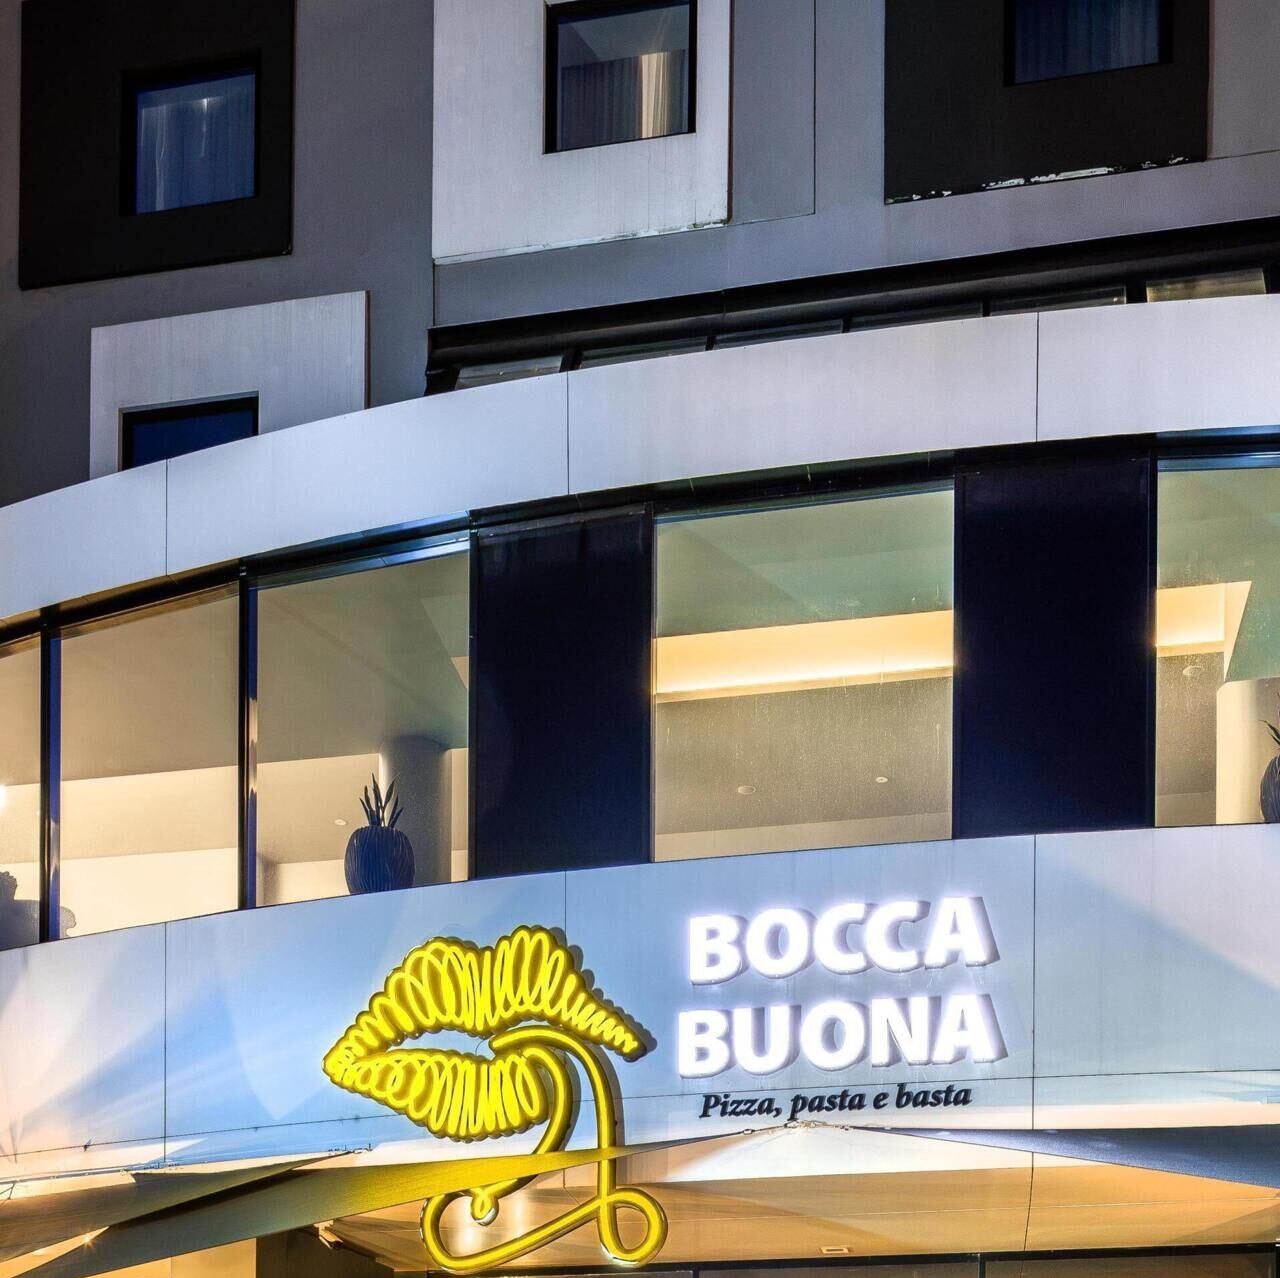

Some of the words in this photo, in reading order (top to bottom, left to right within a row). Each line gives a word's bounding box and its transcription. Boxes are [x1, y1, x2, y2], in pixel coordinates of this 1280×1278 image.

[688, 896, 1000, 985] BOCCA
[677, 994, 1007, 1078] BUONA
[698, 1092, 782, 1119] Pizza,
[790, 1089, 866, 1120] pasta
[872, 1092, 889, 1109] e
[895, 1083, 974, 1110] basta
